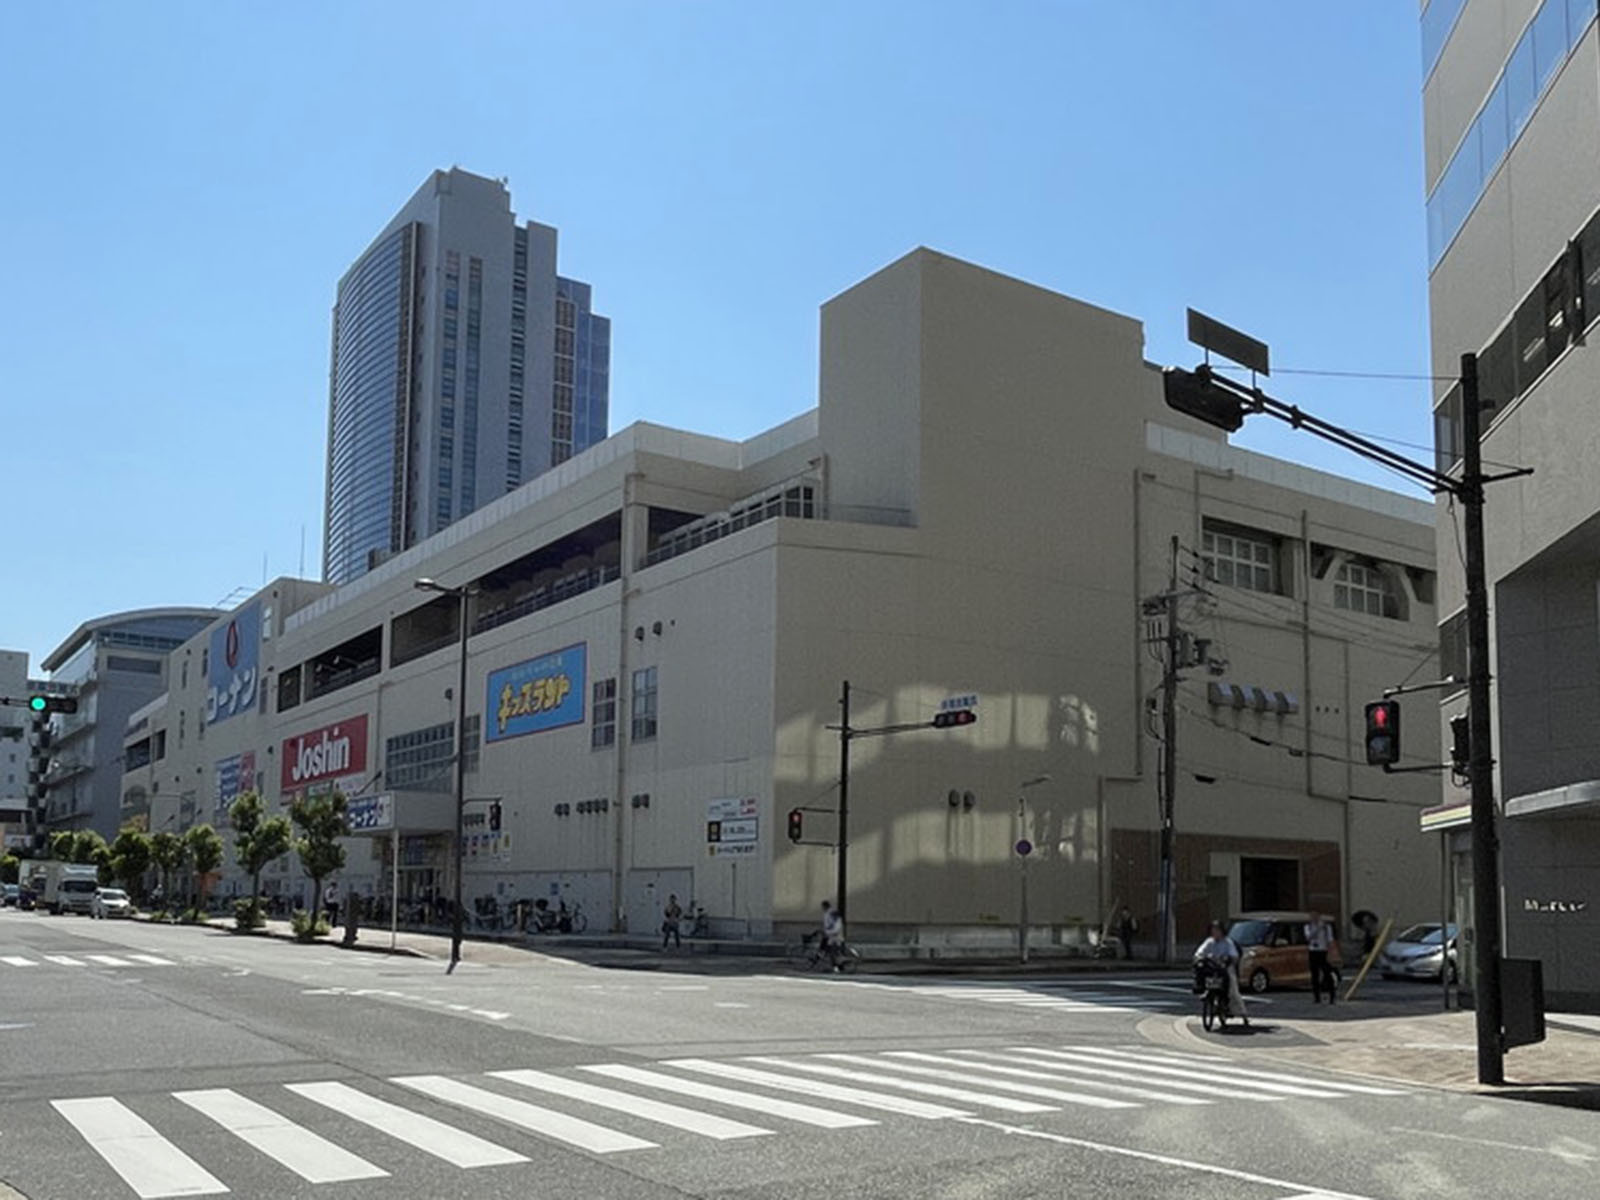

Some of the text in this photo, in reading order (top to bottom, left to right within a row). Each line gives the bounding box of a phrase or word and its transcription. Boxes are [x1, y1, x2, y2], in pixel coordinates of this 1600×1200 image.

[207, 667, 256, 722] コーナン
[292, 725, 349, 781] Joshin
